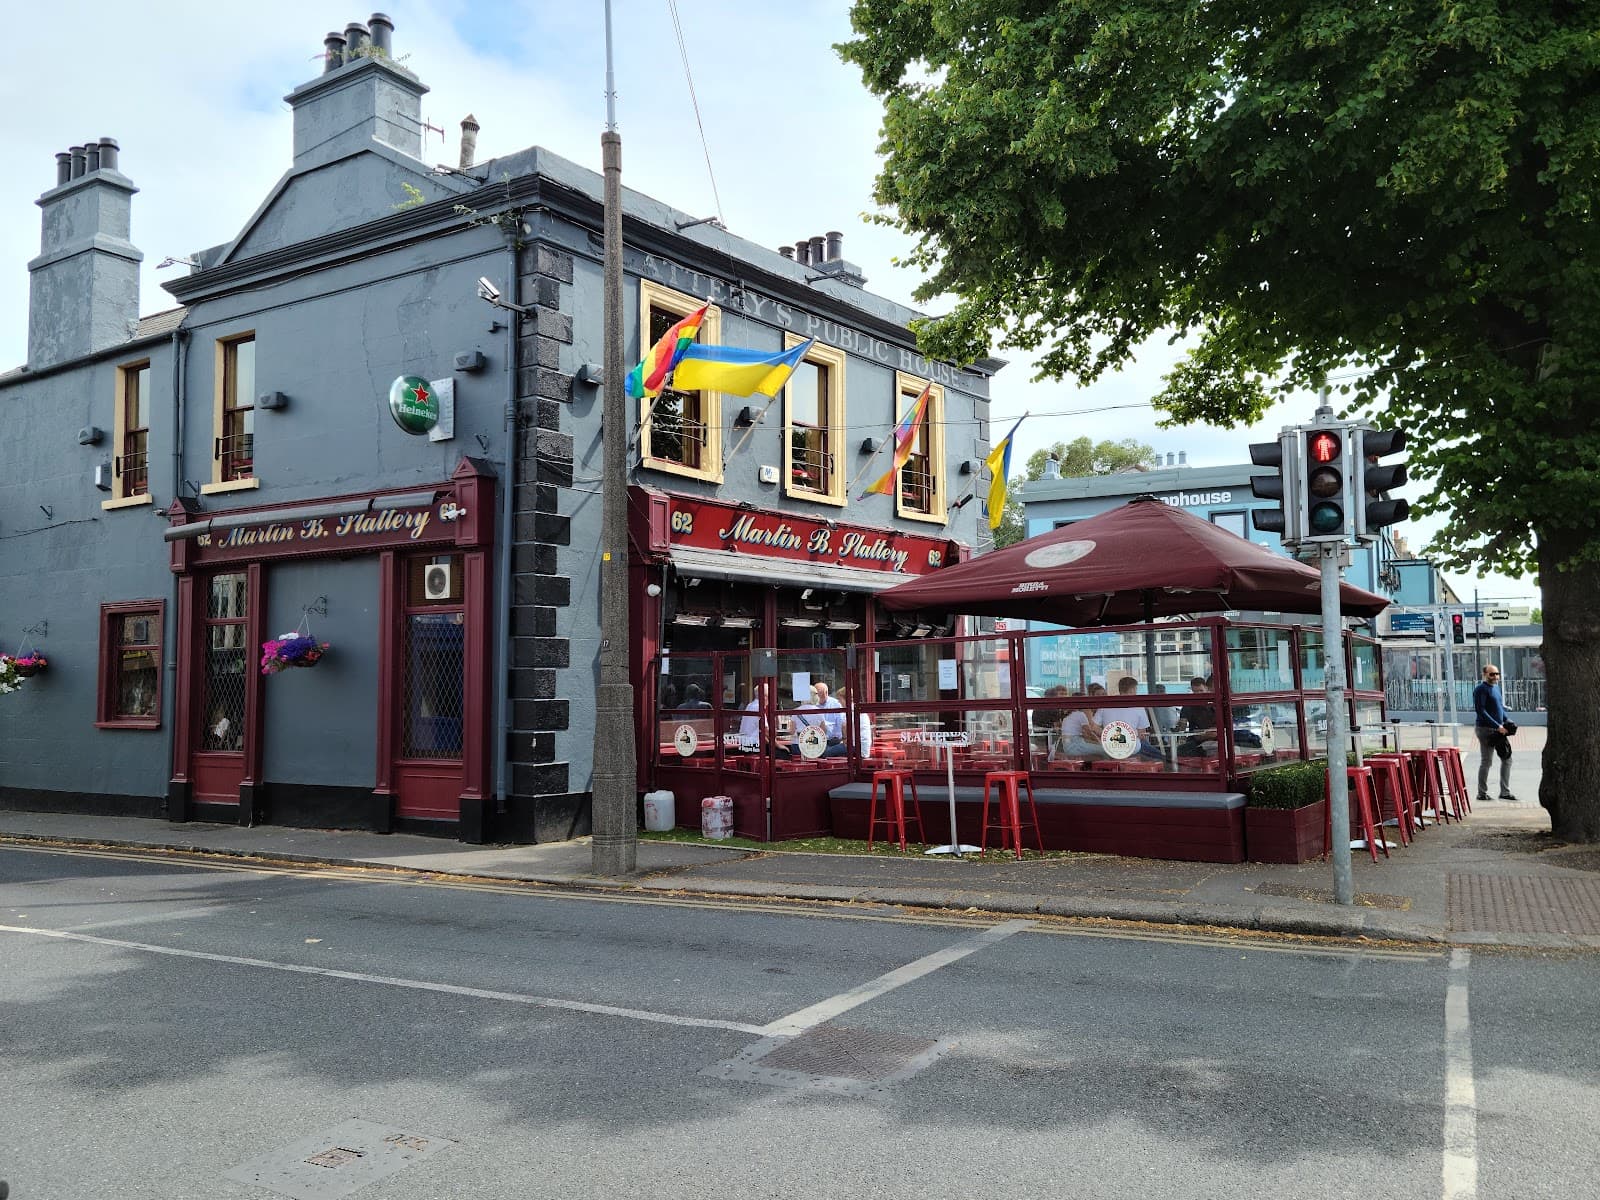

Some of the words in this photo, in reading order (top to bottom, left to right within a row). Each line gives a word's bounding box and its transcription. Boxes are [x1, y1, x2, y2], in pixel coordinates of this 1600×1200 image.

[806, 315, 889, 362] PUBLIC
[900, 351, 961, 388] HOUSE
[218, 523, 295, 549] Martin
[336, 509, 431, 539] Slattery
[671, 511, 694, 535] 62
[719, 514, 802, 550] Martin
[807, 529, 833, 555] B.
[838, 532, 908, 572] Slattery
[926, 549, 942, 568] 62
